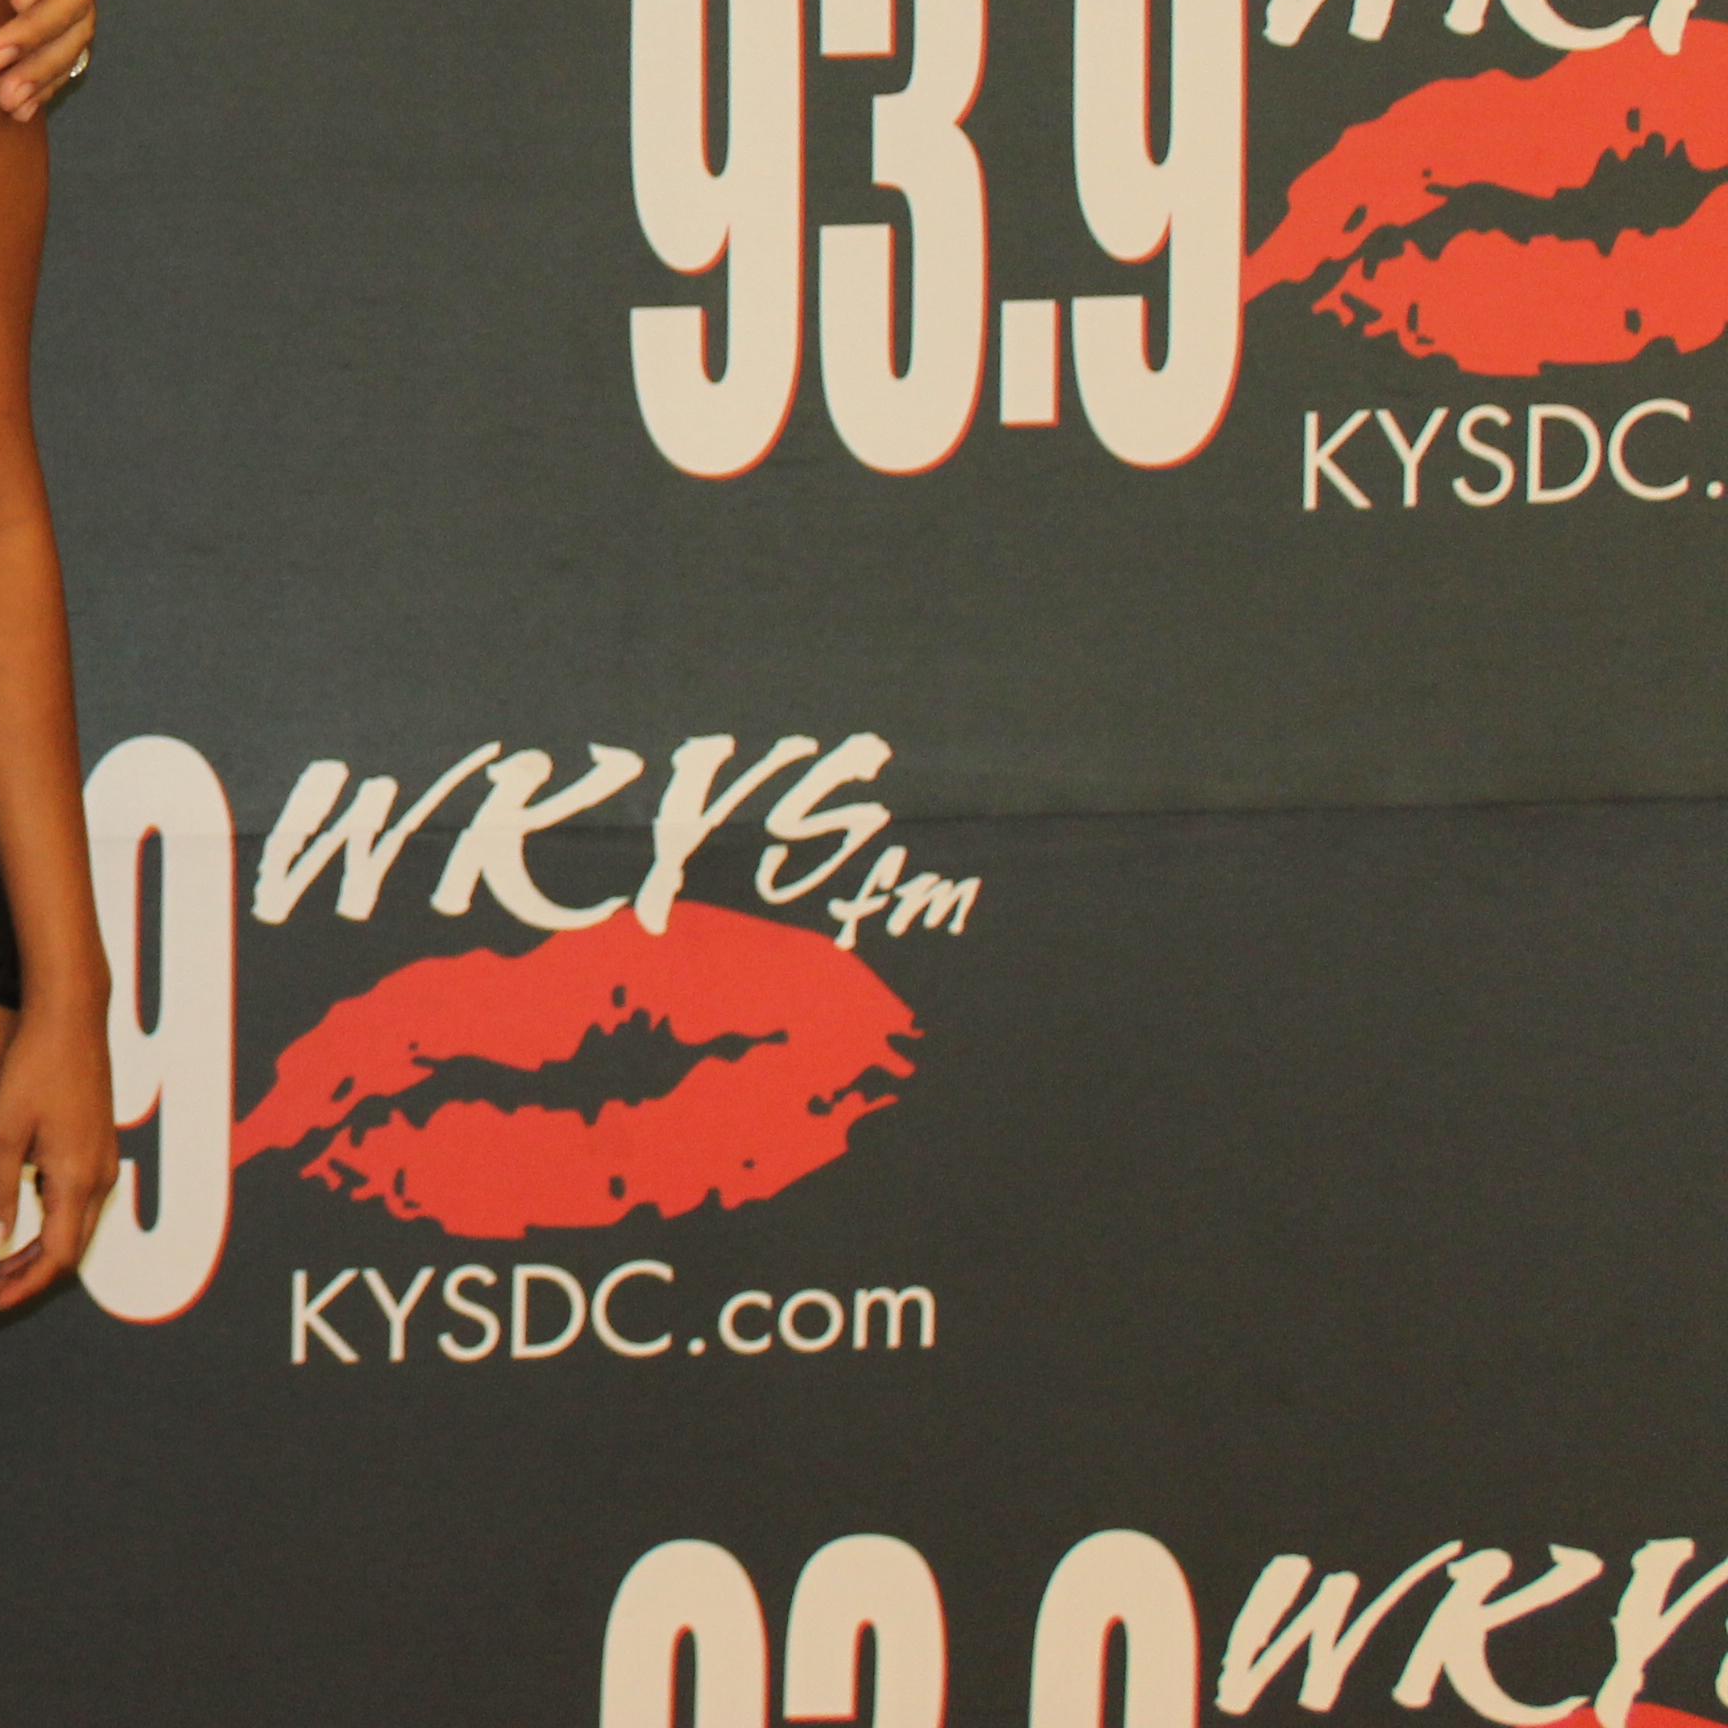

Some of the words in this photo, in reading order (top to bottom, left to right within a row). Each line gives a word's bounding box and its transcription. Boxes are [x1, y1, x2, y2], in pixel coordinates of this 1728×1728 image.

[251, 732, 892, 936] WKYS
[827, 845, 981, 951] fm
[291, 1259, 935, 1364] KYSDC.com
